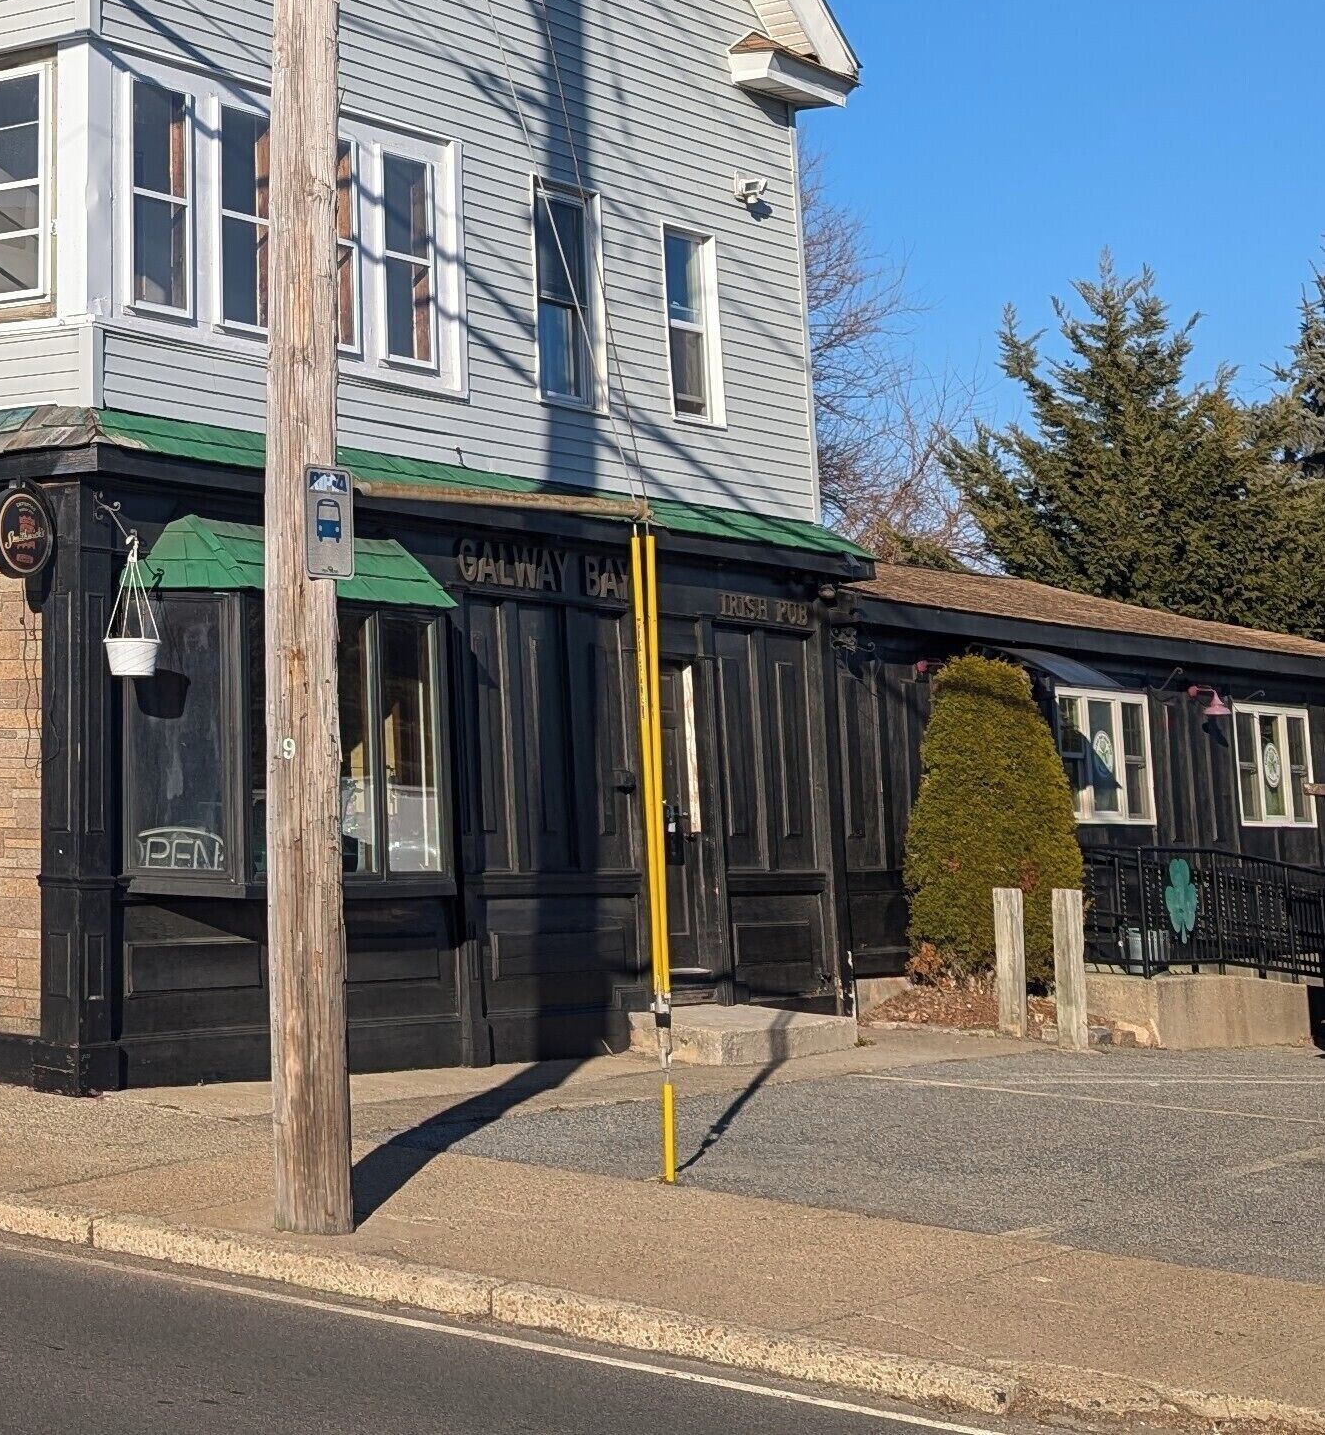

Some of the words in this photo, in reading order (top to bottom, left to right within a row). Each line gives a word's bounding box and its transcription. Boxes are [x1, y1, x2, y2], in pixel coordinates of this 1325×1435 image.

[458, 538, 570, 593] GALWAY
[719, 593, 769, 621] IRISH
[775, 599, 808, 626] PUB
[283, 737, 295, 760] 9
